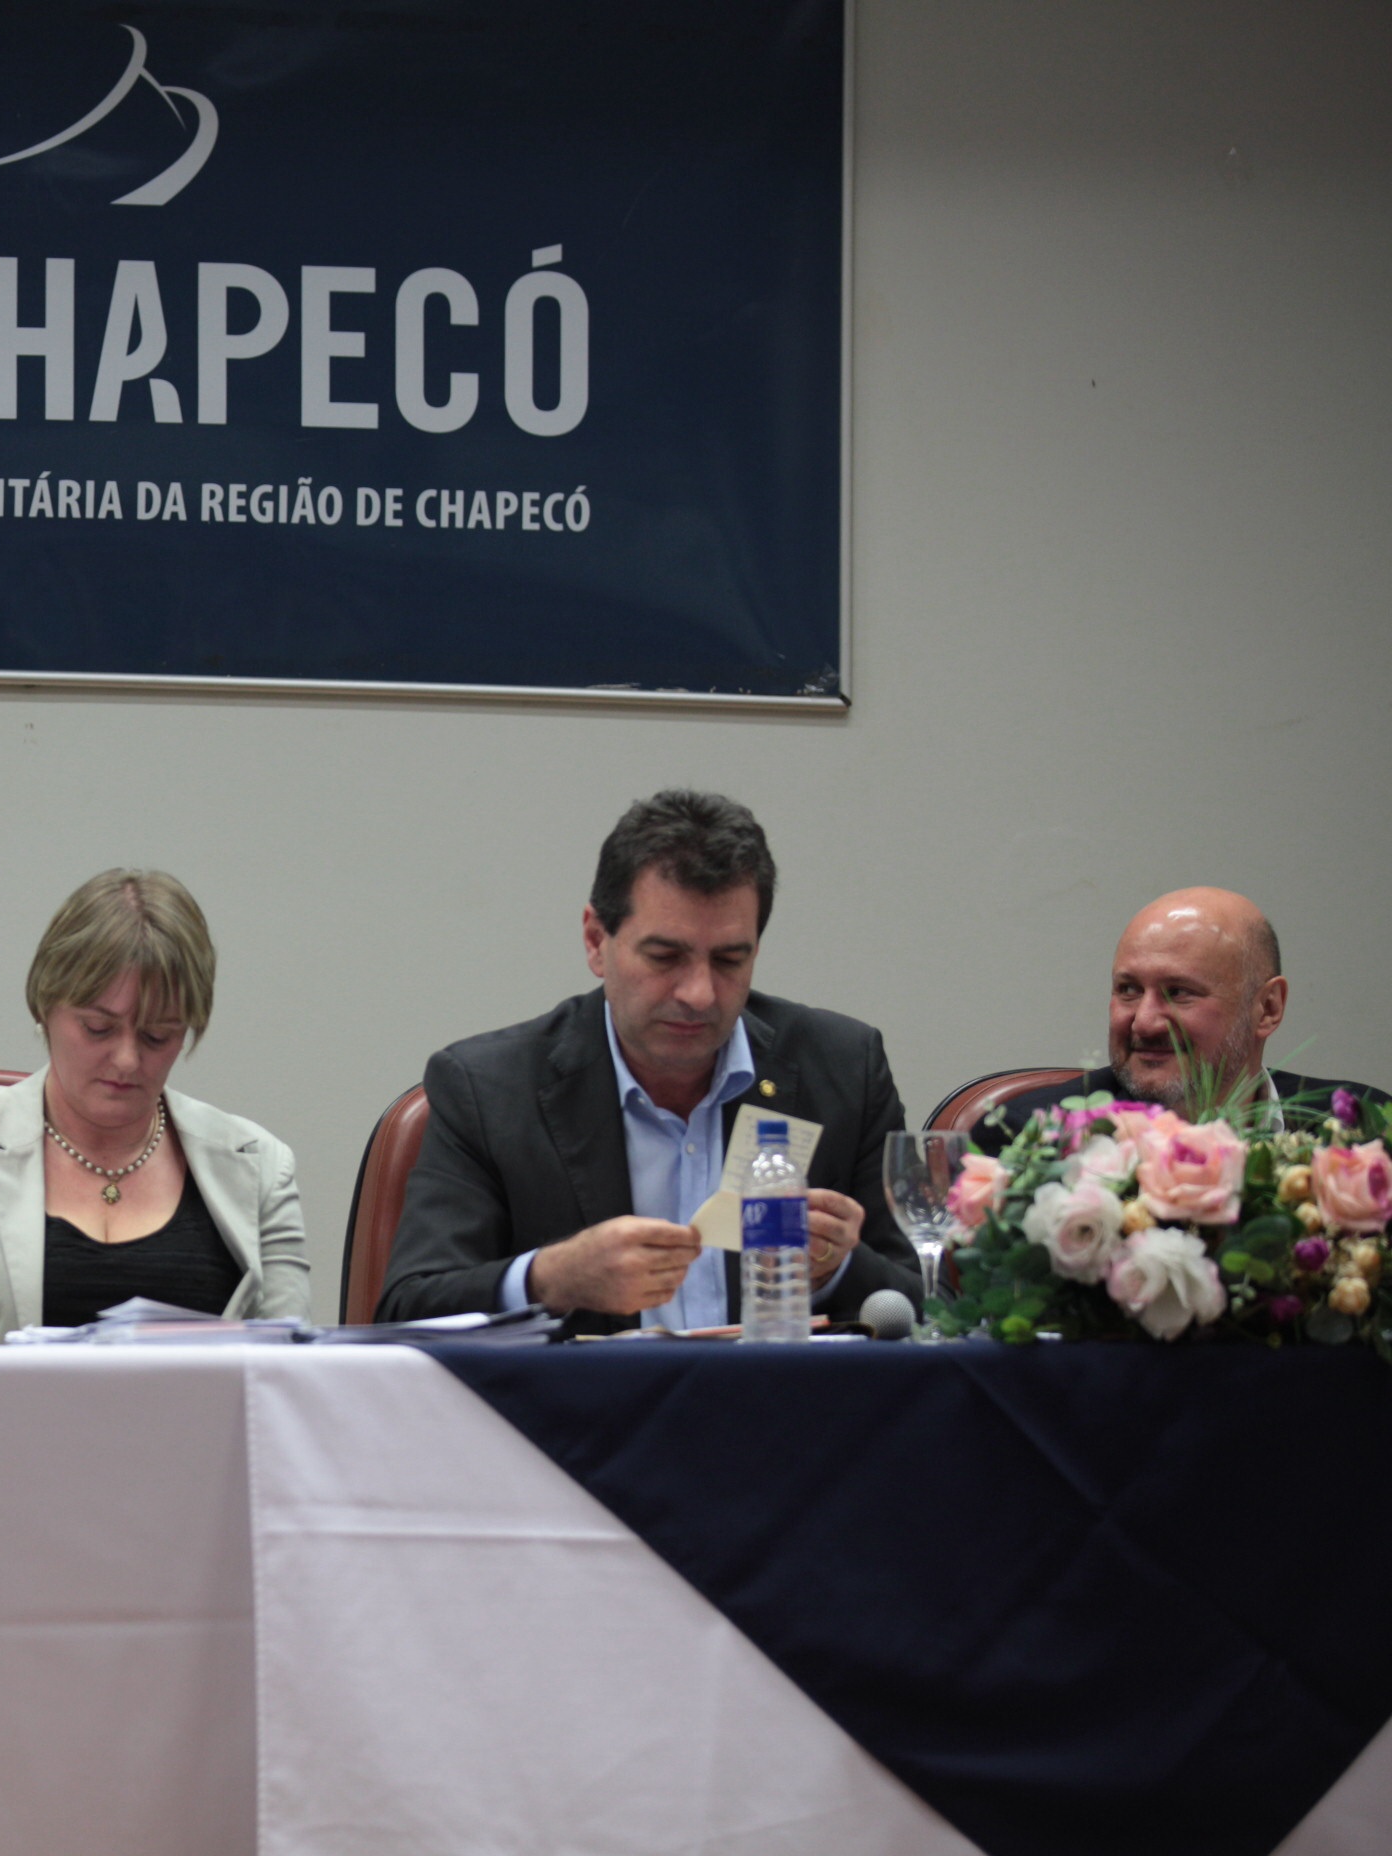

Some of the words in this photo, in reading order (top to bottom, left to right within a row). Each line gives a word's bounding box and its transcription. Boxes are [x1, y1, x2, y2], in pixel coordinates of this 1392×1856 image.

[135, 480, 188, 522] DA
[199, 476, 344, 527] REGIÃO
[355, 486, 405, 528] DE
[414, 485, 592, 533] CHAPECÓ
